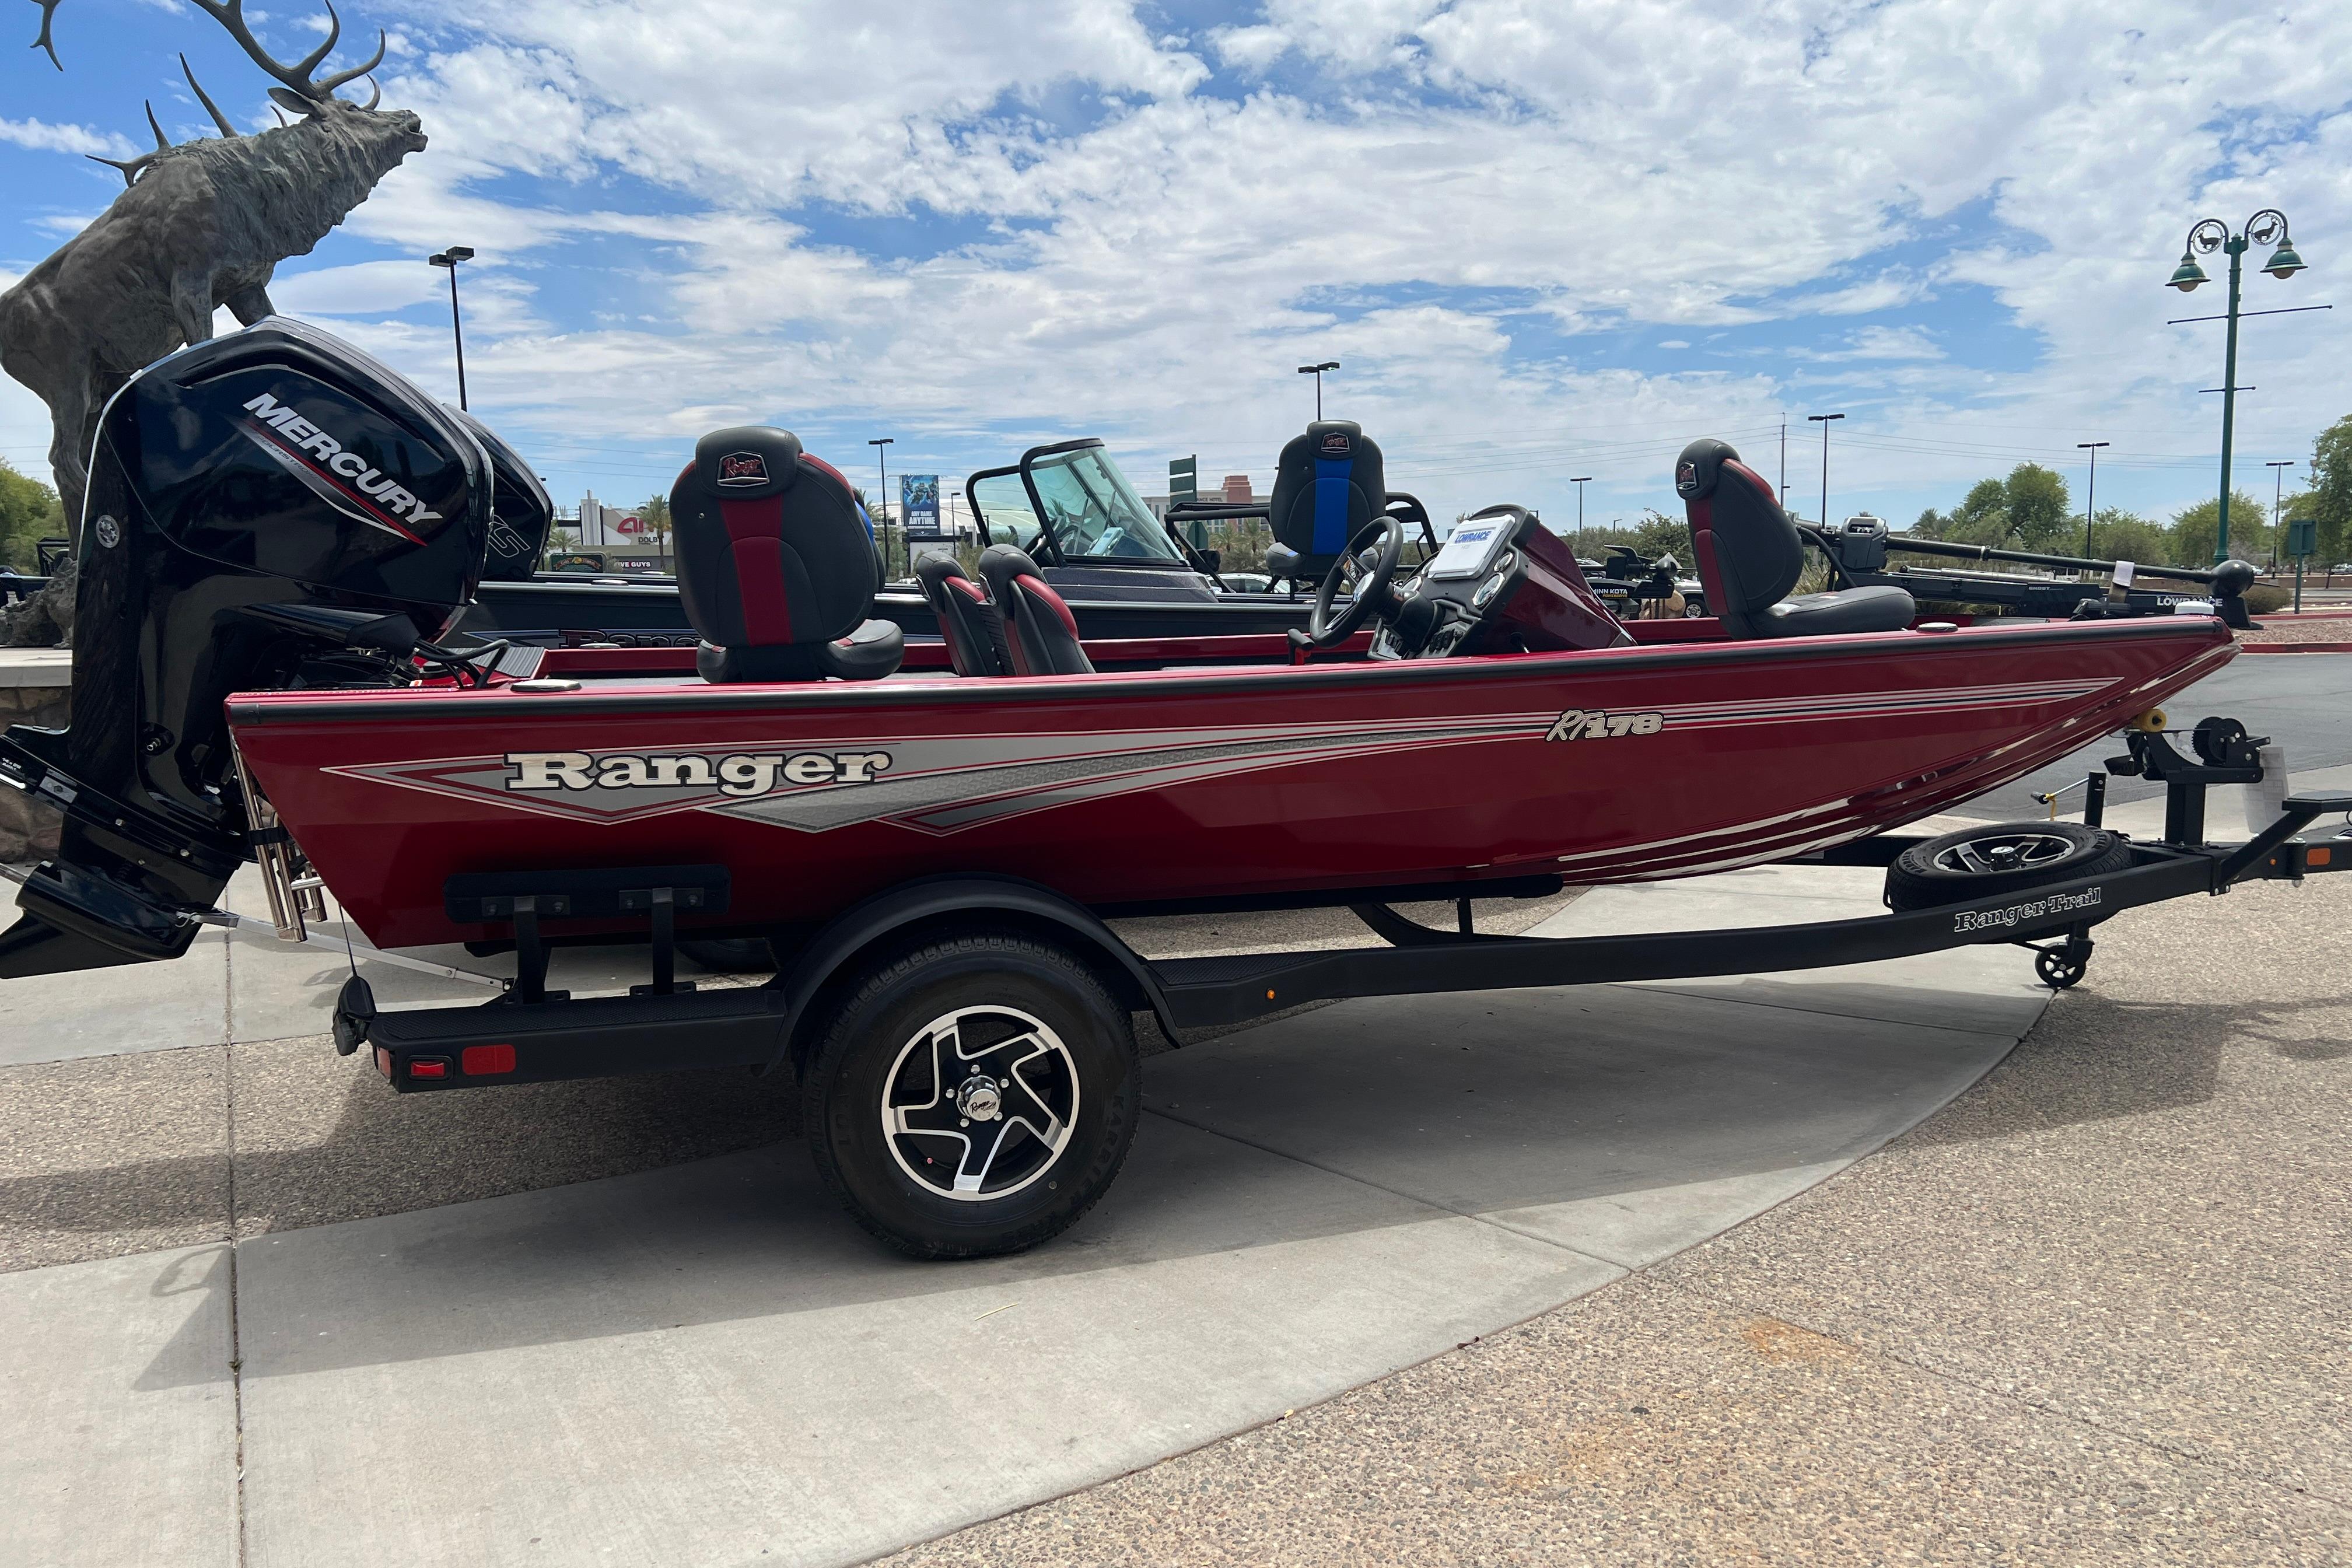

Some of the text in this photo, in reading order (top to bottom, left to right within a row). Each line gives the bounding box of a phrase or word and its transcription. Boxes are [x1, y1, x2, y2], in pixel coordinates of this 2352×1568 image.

[243, 393, 443, 524] MERCURY
[909, 517, 936, 525] ANYTIME
[1454, 530, 1492, 544] LOWRANCE
[505, 751, 893, 797] Ranger
[1954, 887, 2101, 933] Ranger Trail
